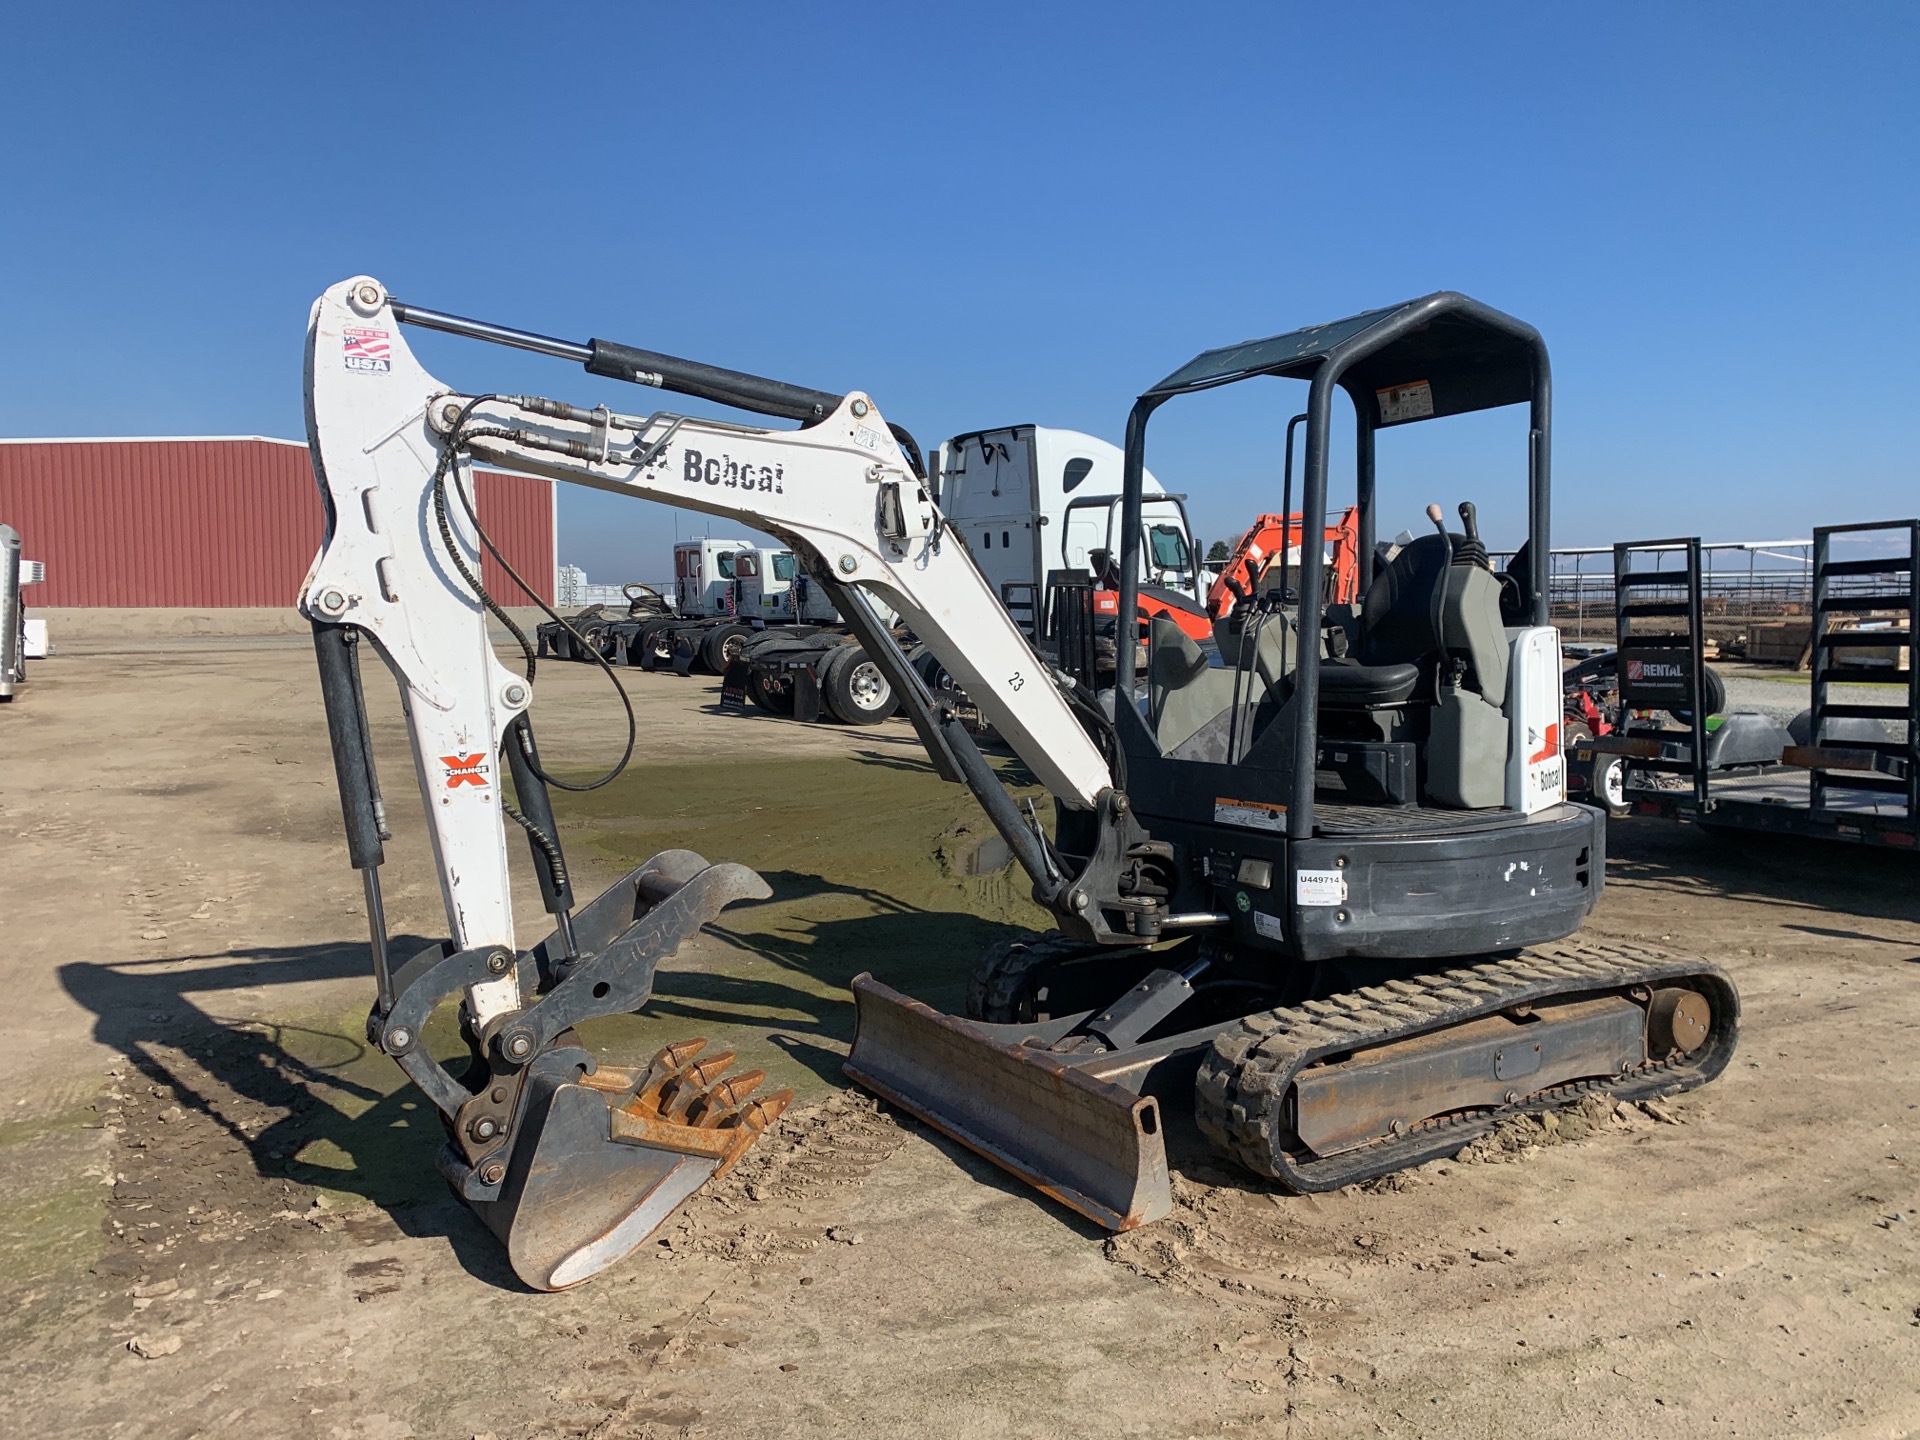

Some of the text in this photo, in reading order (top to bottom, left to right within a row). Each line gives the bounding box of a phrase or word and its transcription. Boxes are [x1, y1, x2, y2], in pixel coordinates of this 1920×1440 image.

[346, 357, 388, 370] USA
[684, 449, 783, 494] Bobcat
[1643, 664, 1683, 676] RENTAL
[1008, 671, 1024, 691] 23
[1541, 765, 1560, 792] Bobcat
